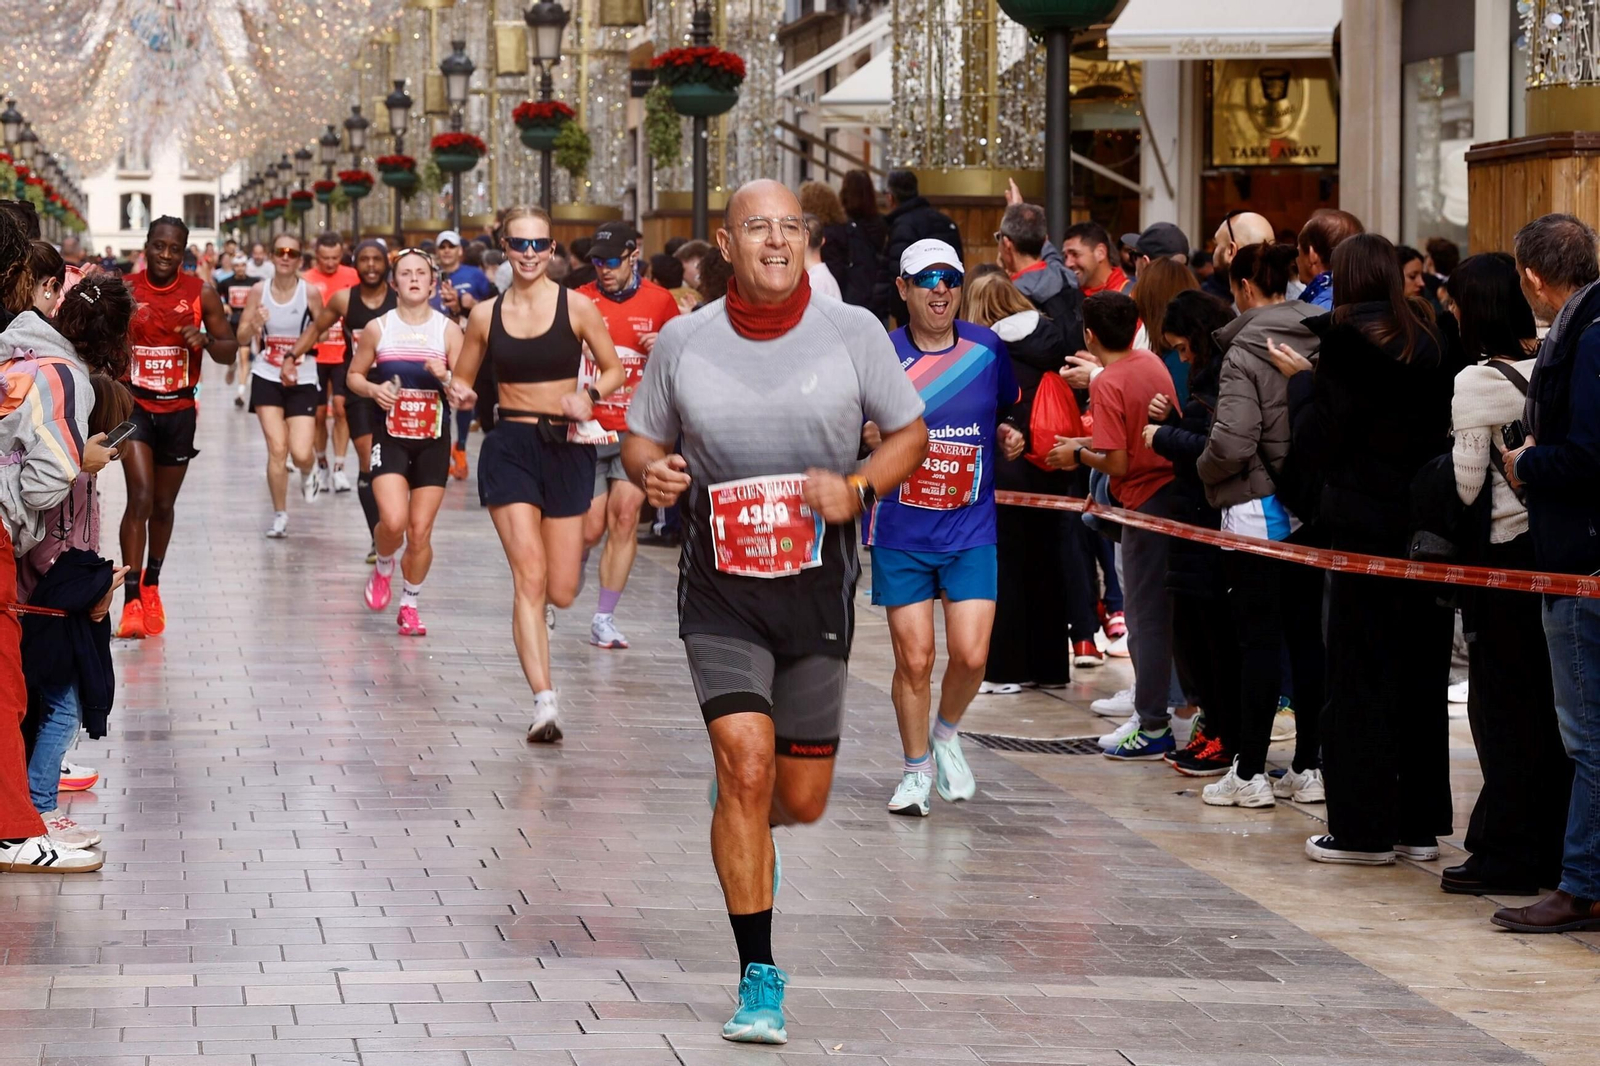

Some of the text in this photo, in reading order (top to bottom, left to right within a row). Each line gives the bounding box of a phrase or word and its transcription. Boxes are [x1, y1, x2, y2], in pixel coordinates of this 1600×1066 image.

[1230, 145, 1320, 159] TAKE AWAY
[145, 359, 173, 370] 5574
[400, 401, 427, 412] 8397
[927, 423, 980, 438] subook
[922, 458, 959, 474] 4360
